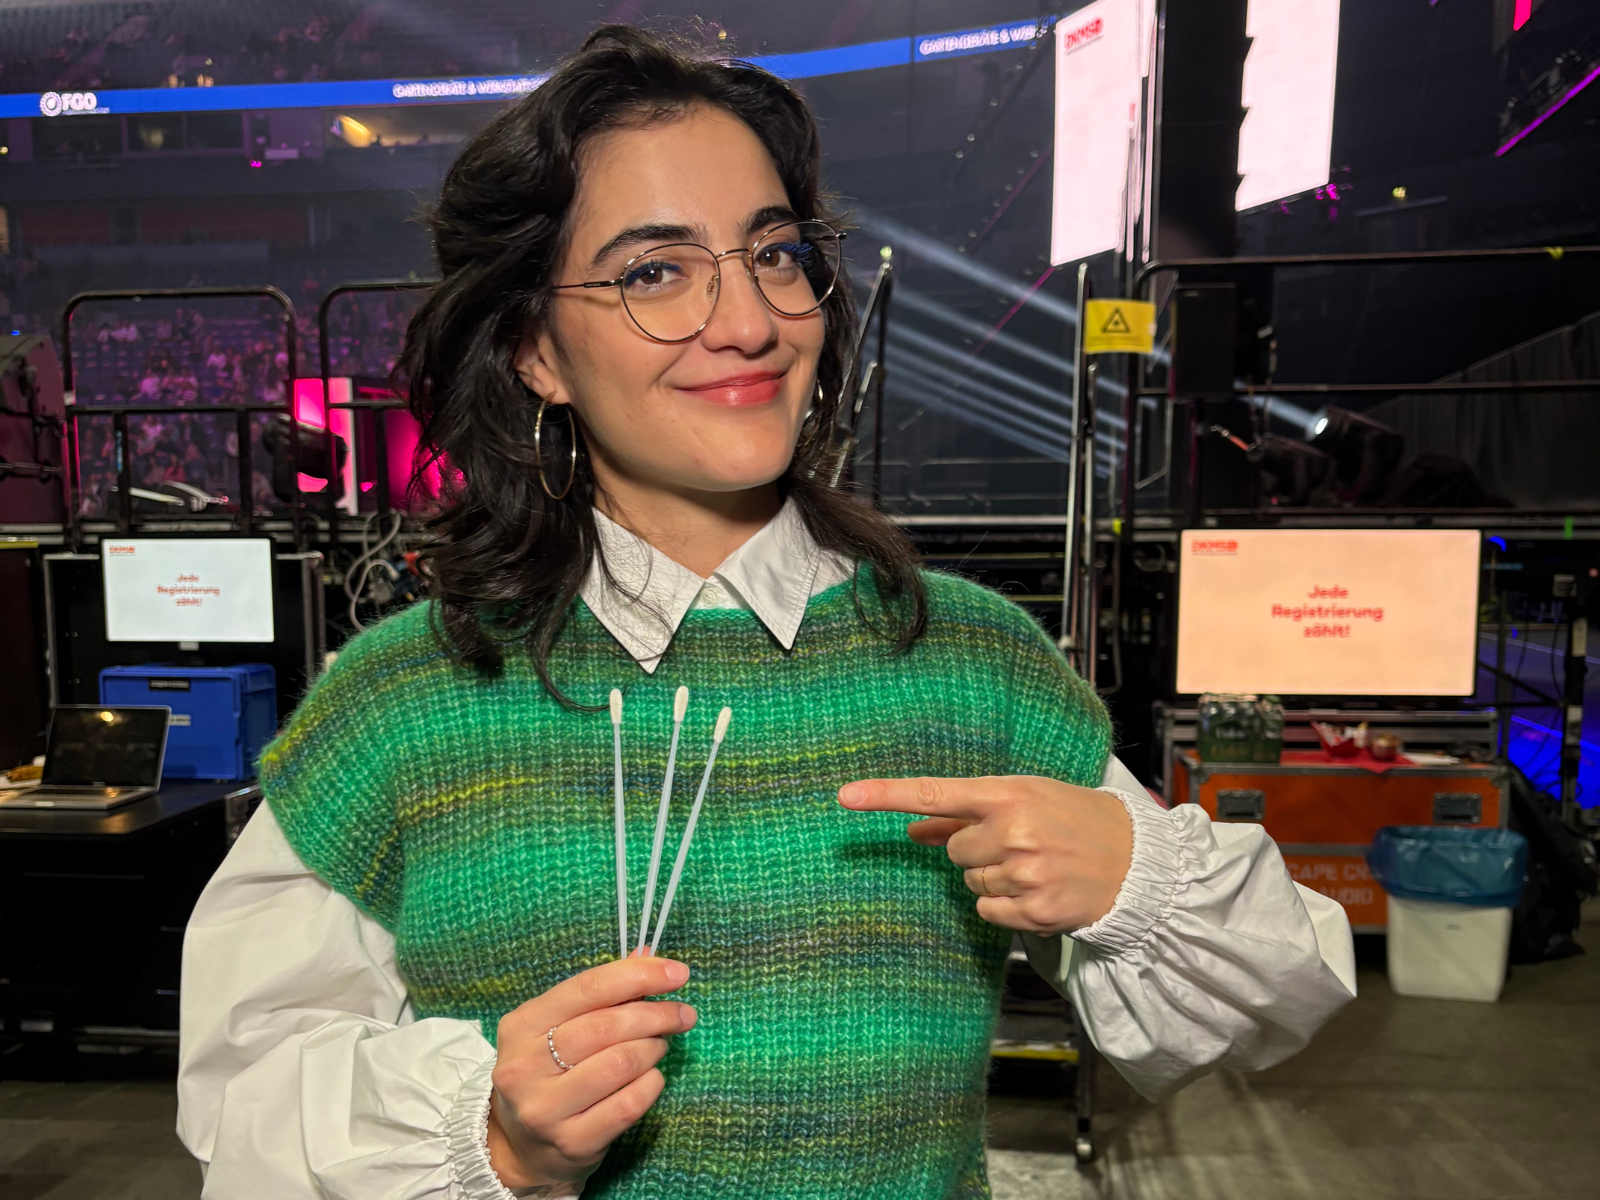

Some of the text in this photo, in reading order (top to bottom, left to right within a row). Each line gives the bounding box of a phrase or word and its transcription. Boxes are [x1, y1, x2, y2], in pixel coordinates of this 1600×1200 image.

[177, 573, 200, 583] Jede
[157, 584, 220, 596] Registrierung
[1307, 584, 1349, 599] Jede
[1271, 602, 1384, 623] Registrierung
[1303, 622, 1351, 638] zählt!
